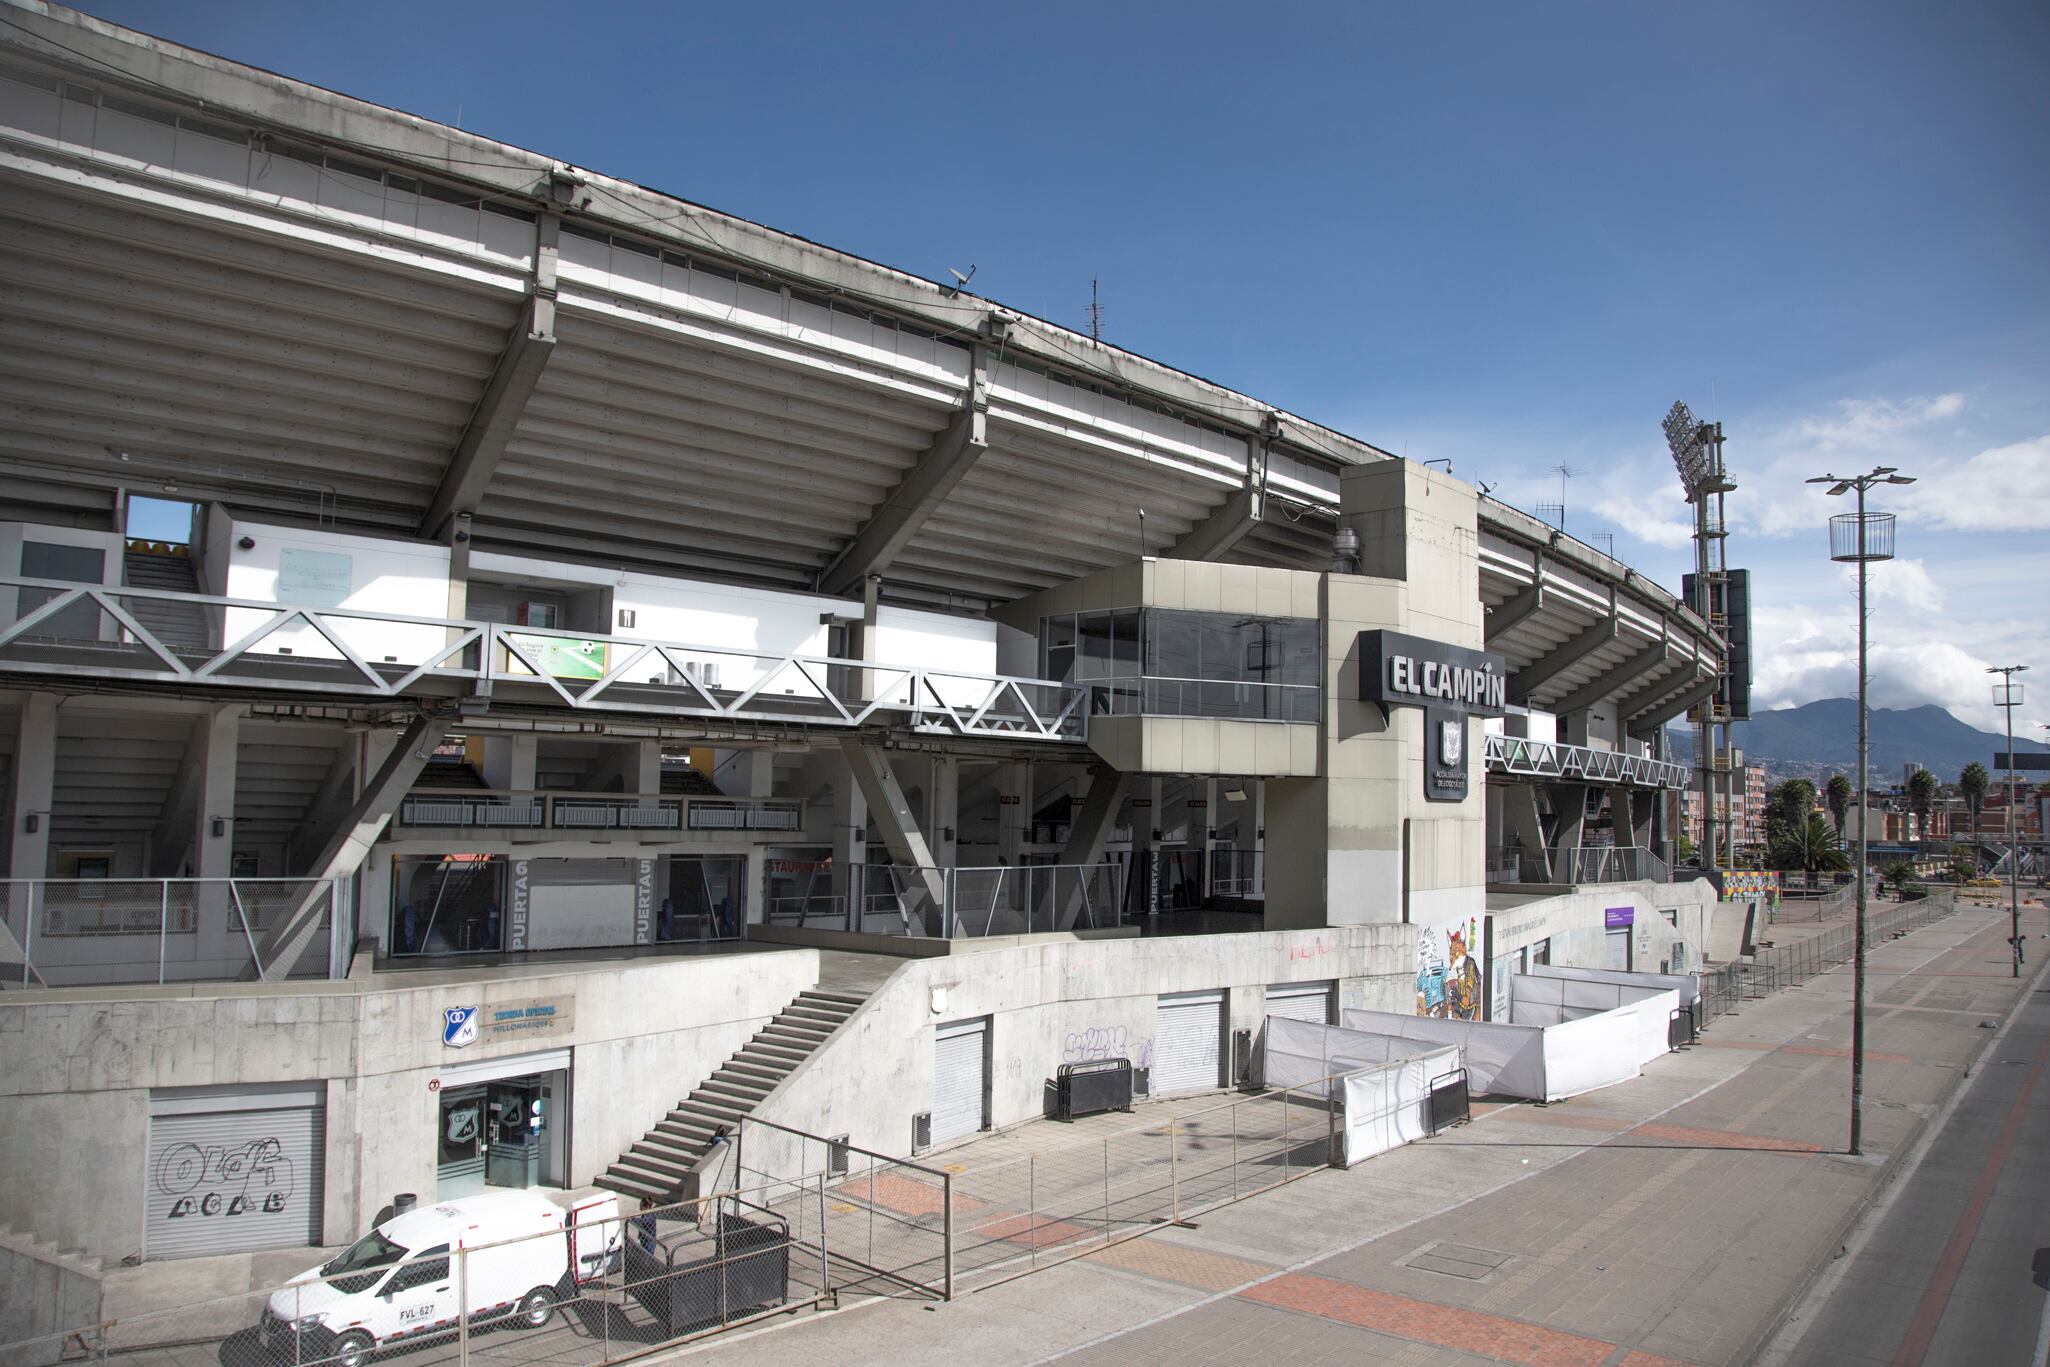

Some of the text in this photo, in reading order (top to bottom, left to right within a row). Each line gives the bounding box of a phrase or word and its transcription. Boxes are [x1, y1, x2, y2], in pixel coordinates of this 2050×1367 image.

[1391, 655, 1505, 708] EL CAMPÍN
[400, 1304, 434, 1320] FVL 627
